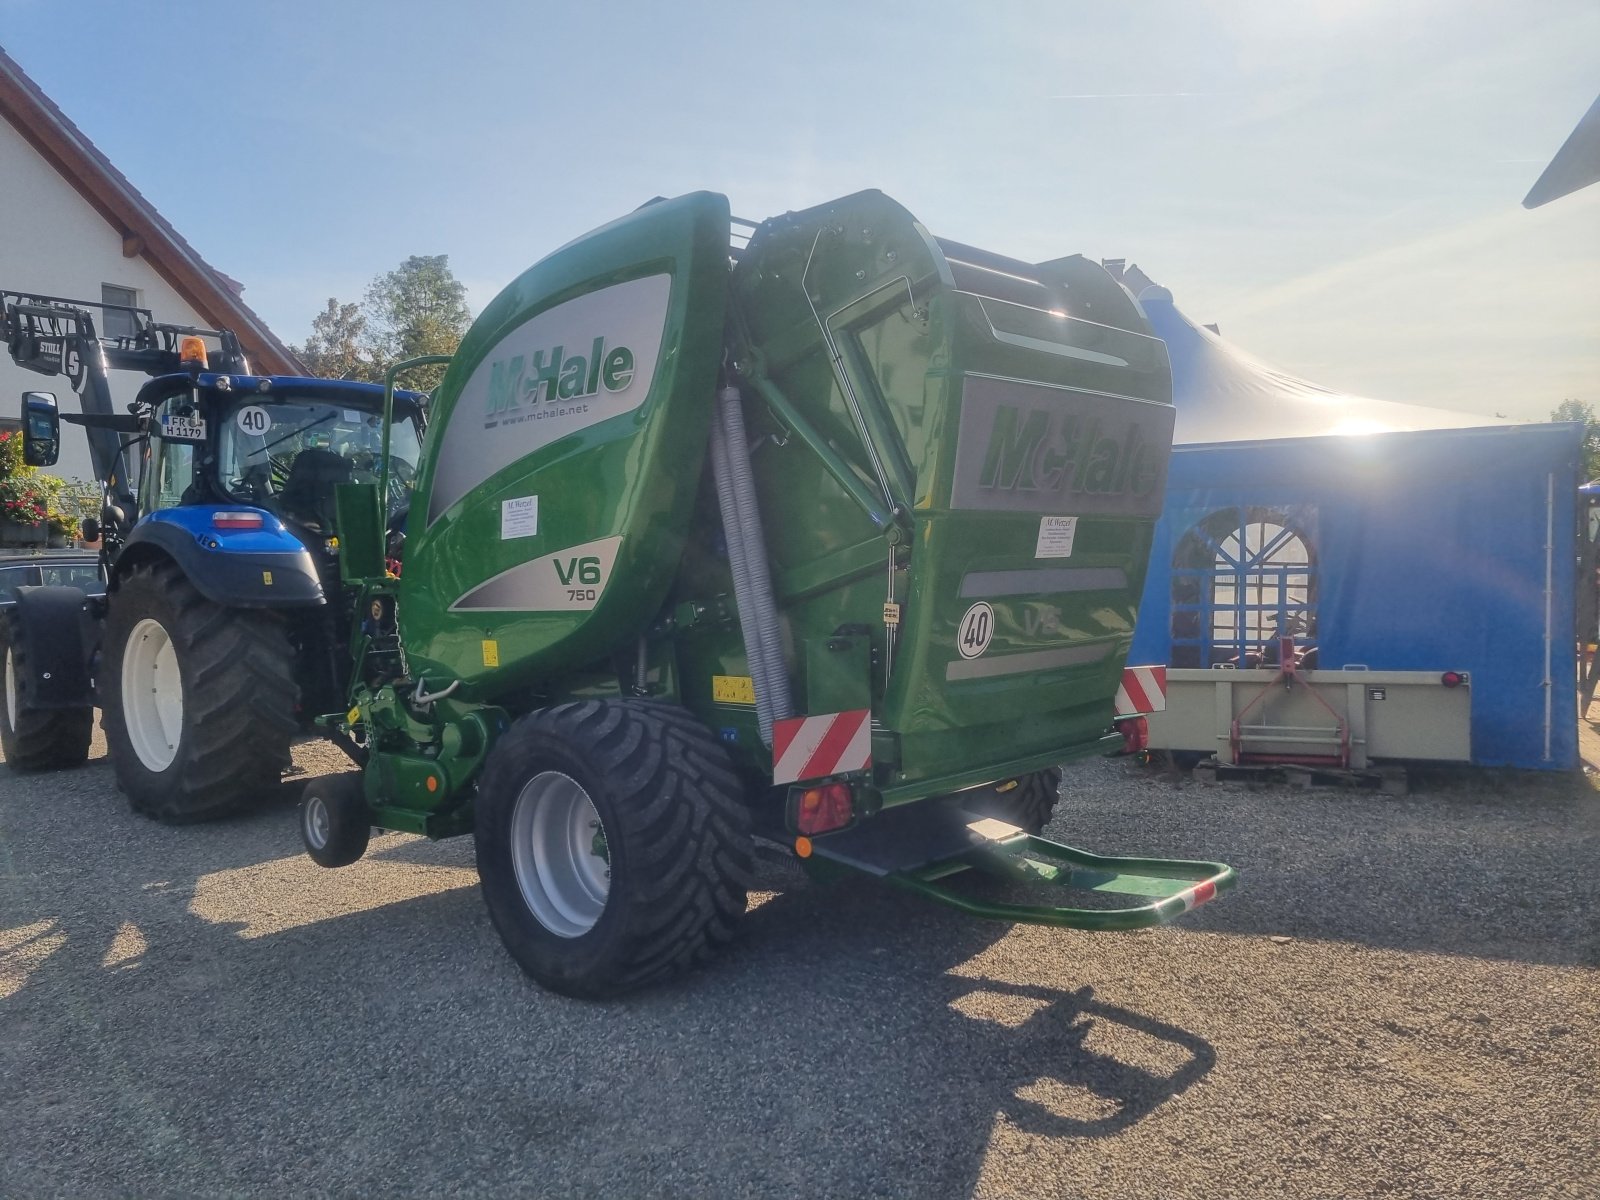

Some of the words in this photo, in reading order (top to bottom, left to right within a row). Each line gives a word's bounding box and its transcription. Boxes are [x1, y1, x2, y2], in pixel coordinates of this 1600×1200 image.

[40, 342, 61, 355] STOLL
[485, 335, 635, 417] McHale
[172, 417, 186, 427] FR
[243, 411, 265, 430] 40
[502, 403, 589, 426] www.mchale.net
[166, 426, 174, 436] H
[176, 428, 202, 438] 1179
[979, 404, 1158, 498] McHale
[553, 556, 600, 585] V6
[567, 589, 596, 601] 750
[963, 611, 988, 648] 40
